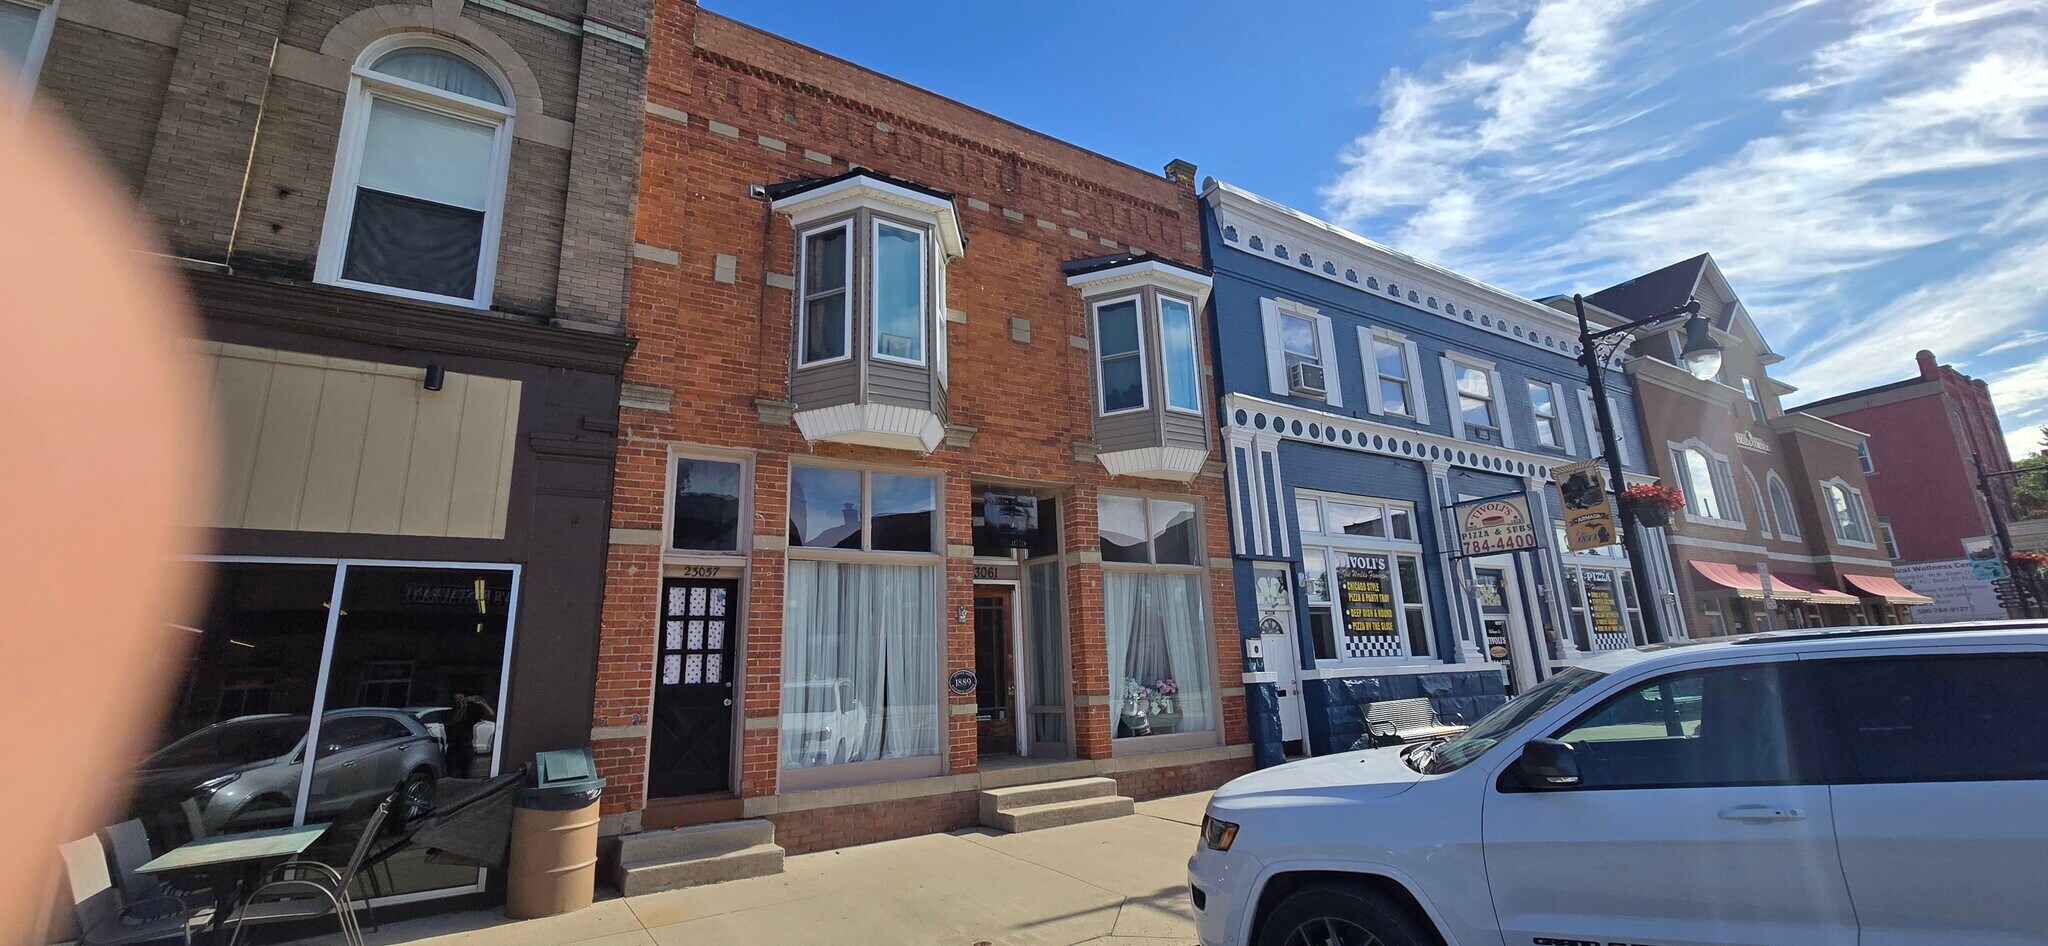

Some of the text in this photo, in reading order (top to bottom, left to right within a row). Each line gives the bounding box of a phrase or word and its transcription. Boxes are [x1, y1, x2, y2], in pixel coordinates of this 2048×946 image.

[1471, 503, 1513, 519] TIVOLI'S
[1578, 514, 1602, 522] ARMADA
[1461, 524, 1532, 540] PIZZA & SUBS
[1463, 534, 1534, 554] 784-4400
[684, 566, 720, 577] 23057
[974, 566, 998, 578] 3061
[1912, 563, 1952, 572] Wellness
[1585, 571, 1612, 582] PIZZA
[1347, 582, 1380, 591] CHICAGO STYLE
[1348, 593, 1361, 602] PIZZA
[1366, 593, 1379, 602] PARTY
[1350, 608, 1362, 618] DEEP
[1362, 609, 1373, 617] DISH
[1352, 621, 1394, 631] PIZZA BY THE SLICE
[955, 677, 972, 687] 1889
